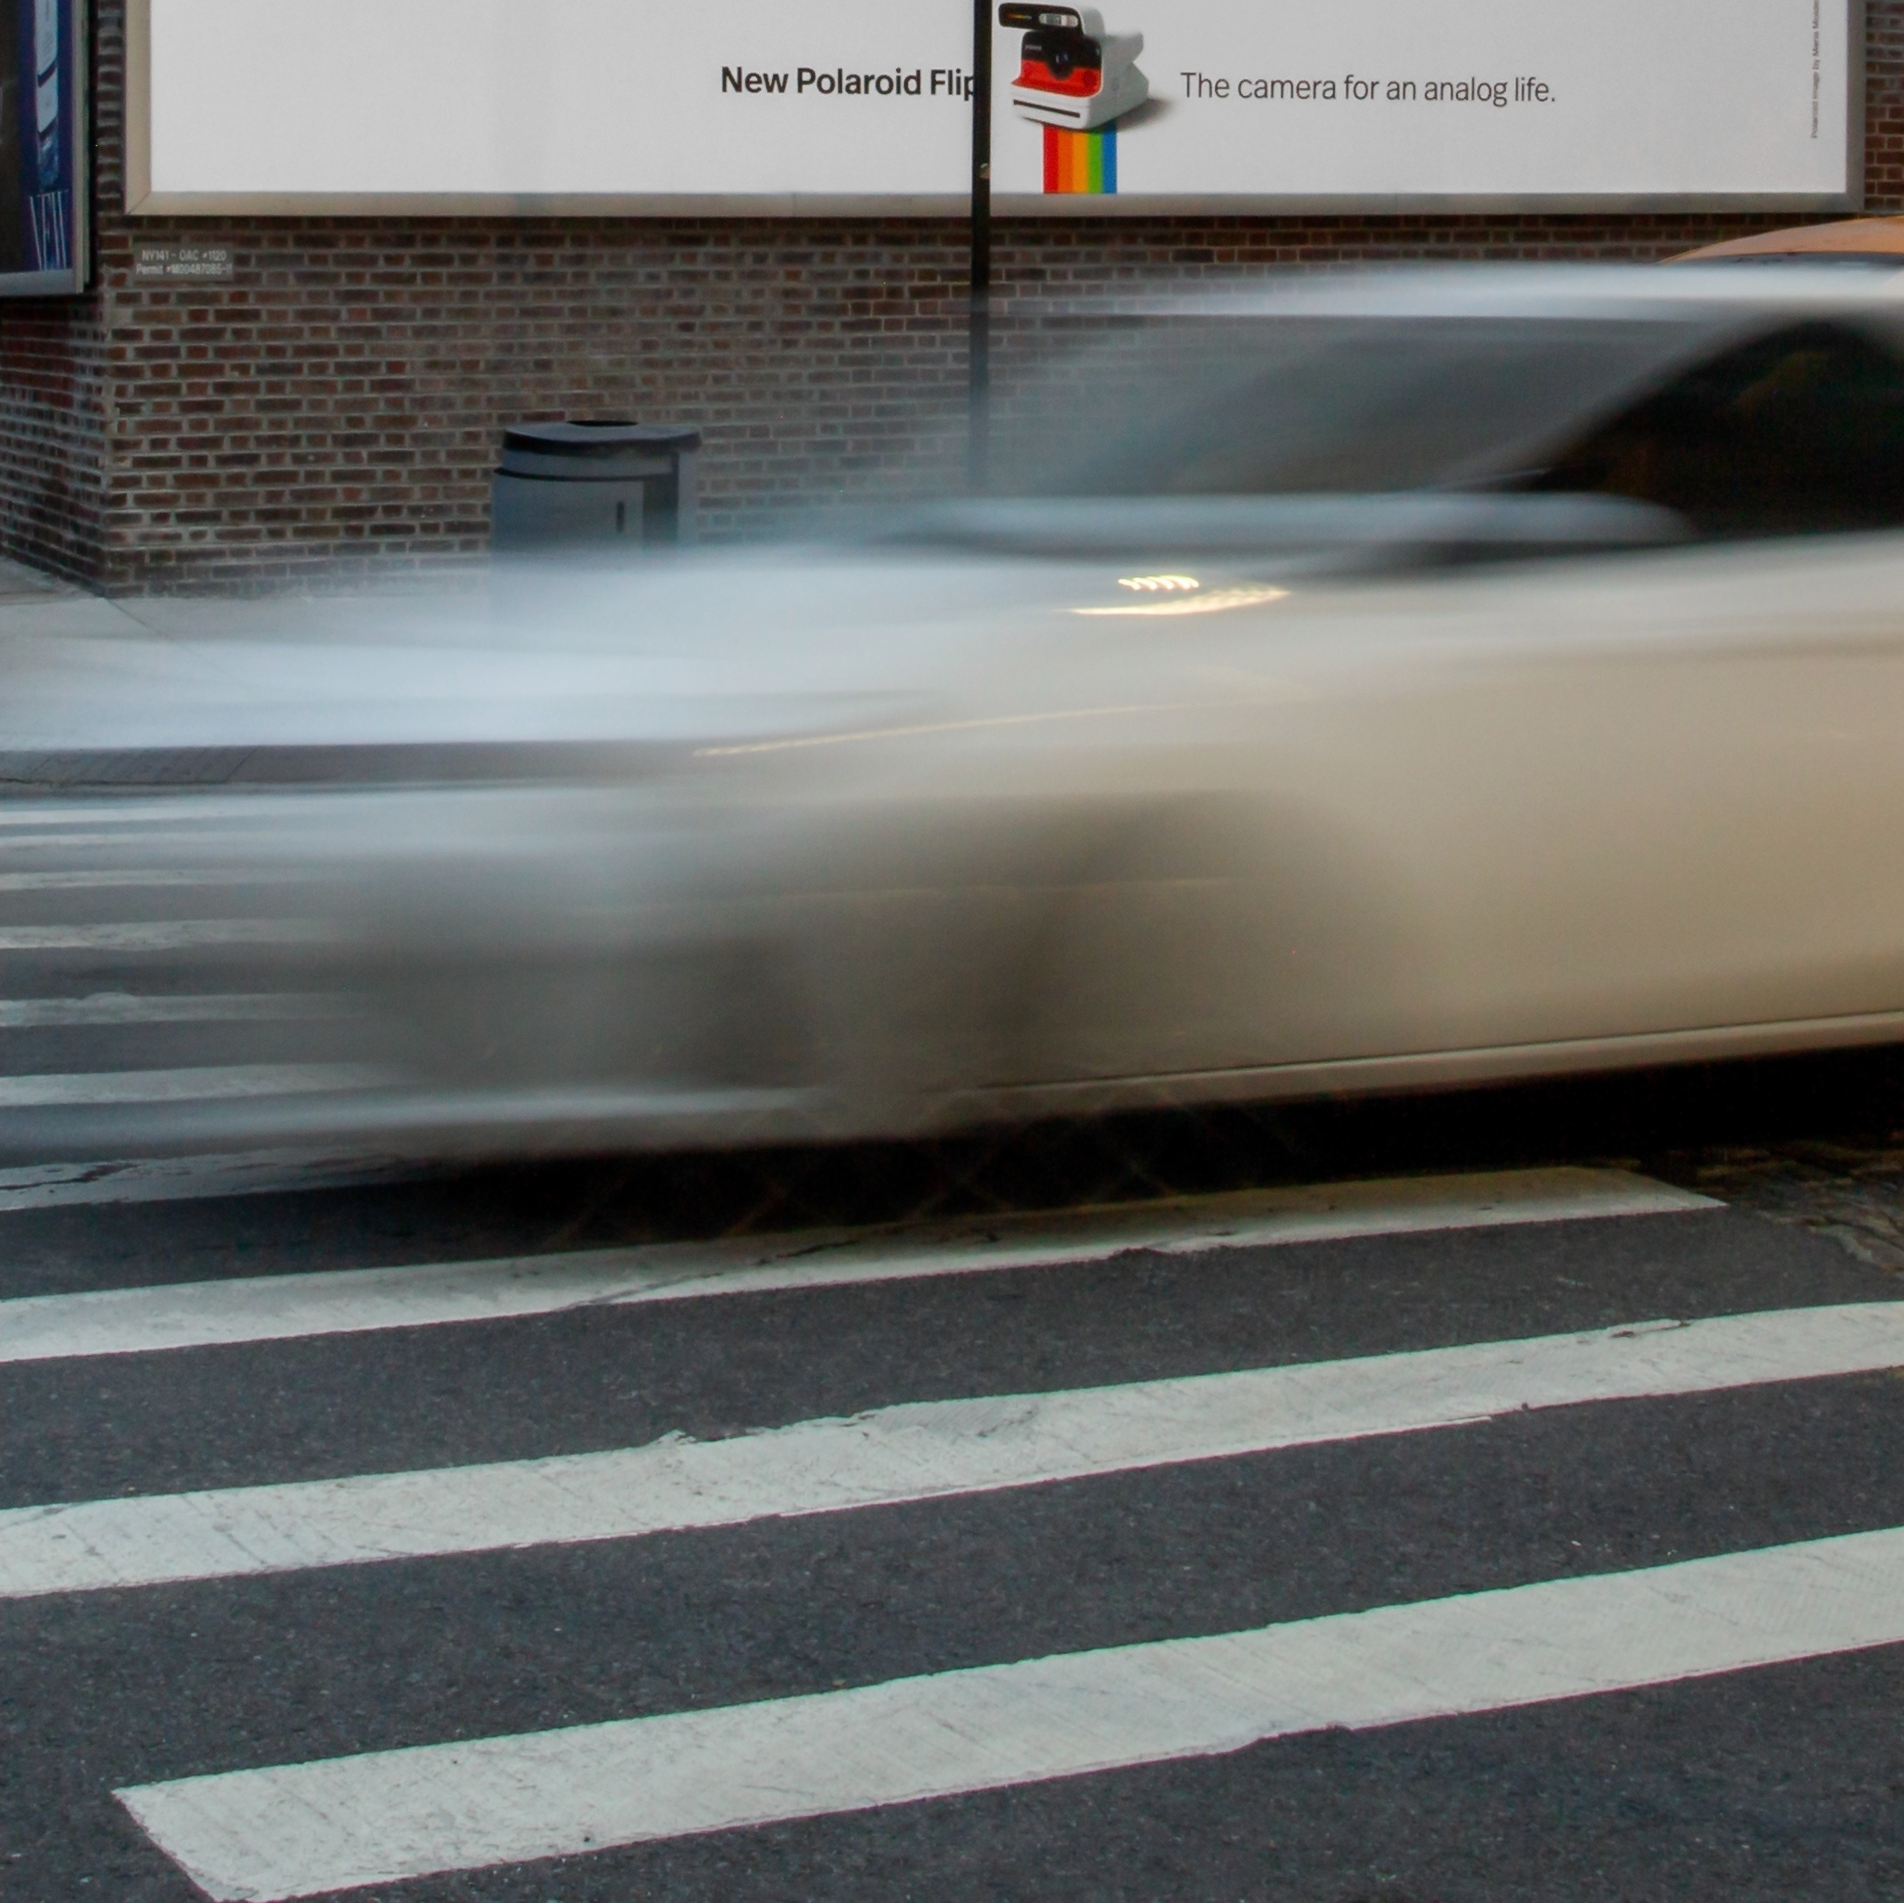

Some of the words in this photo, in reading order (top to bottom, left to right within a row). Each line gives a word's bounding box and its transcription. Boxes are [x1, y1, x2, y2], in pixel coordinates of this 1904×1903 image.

[721, 66, 789, 94] New
[796, 67, 922, 96] Polaroid
[930, 68, 974, 102] Flip
[1180, 72, 1230, 99] The
[1237, 79, 1336, 100] camera
[1343, 74, 1380, 101] for
[1386, 81, 1417, 101] an
[1424, 76, 1508, 108] analog
[1515, 76, 1556, 103] life.
